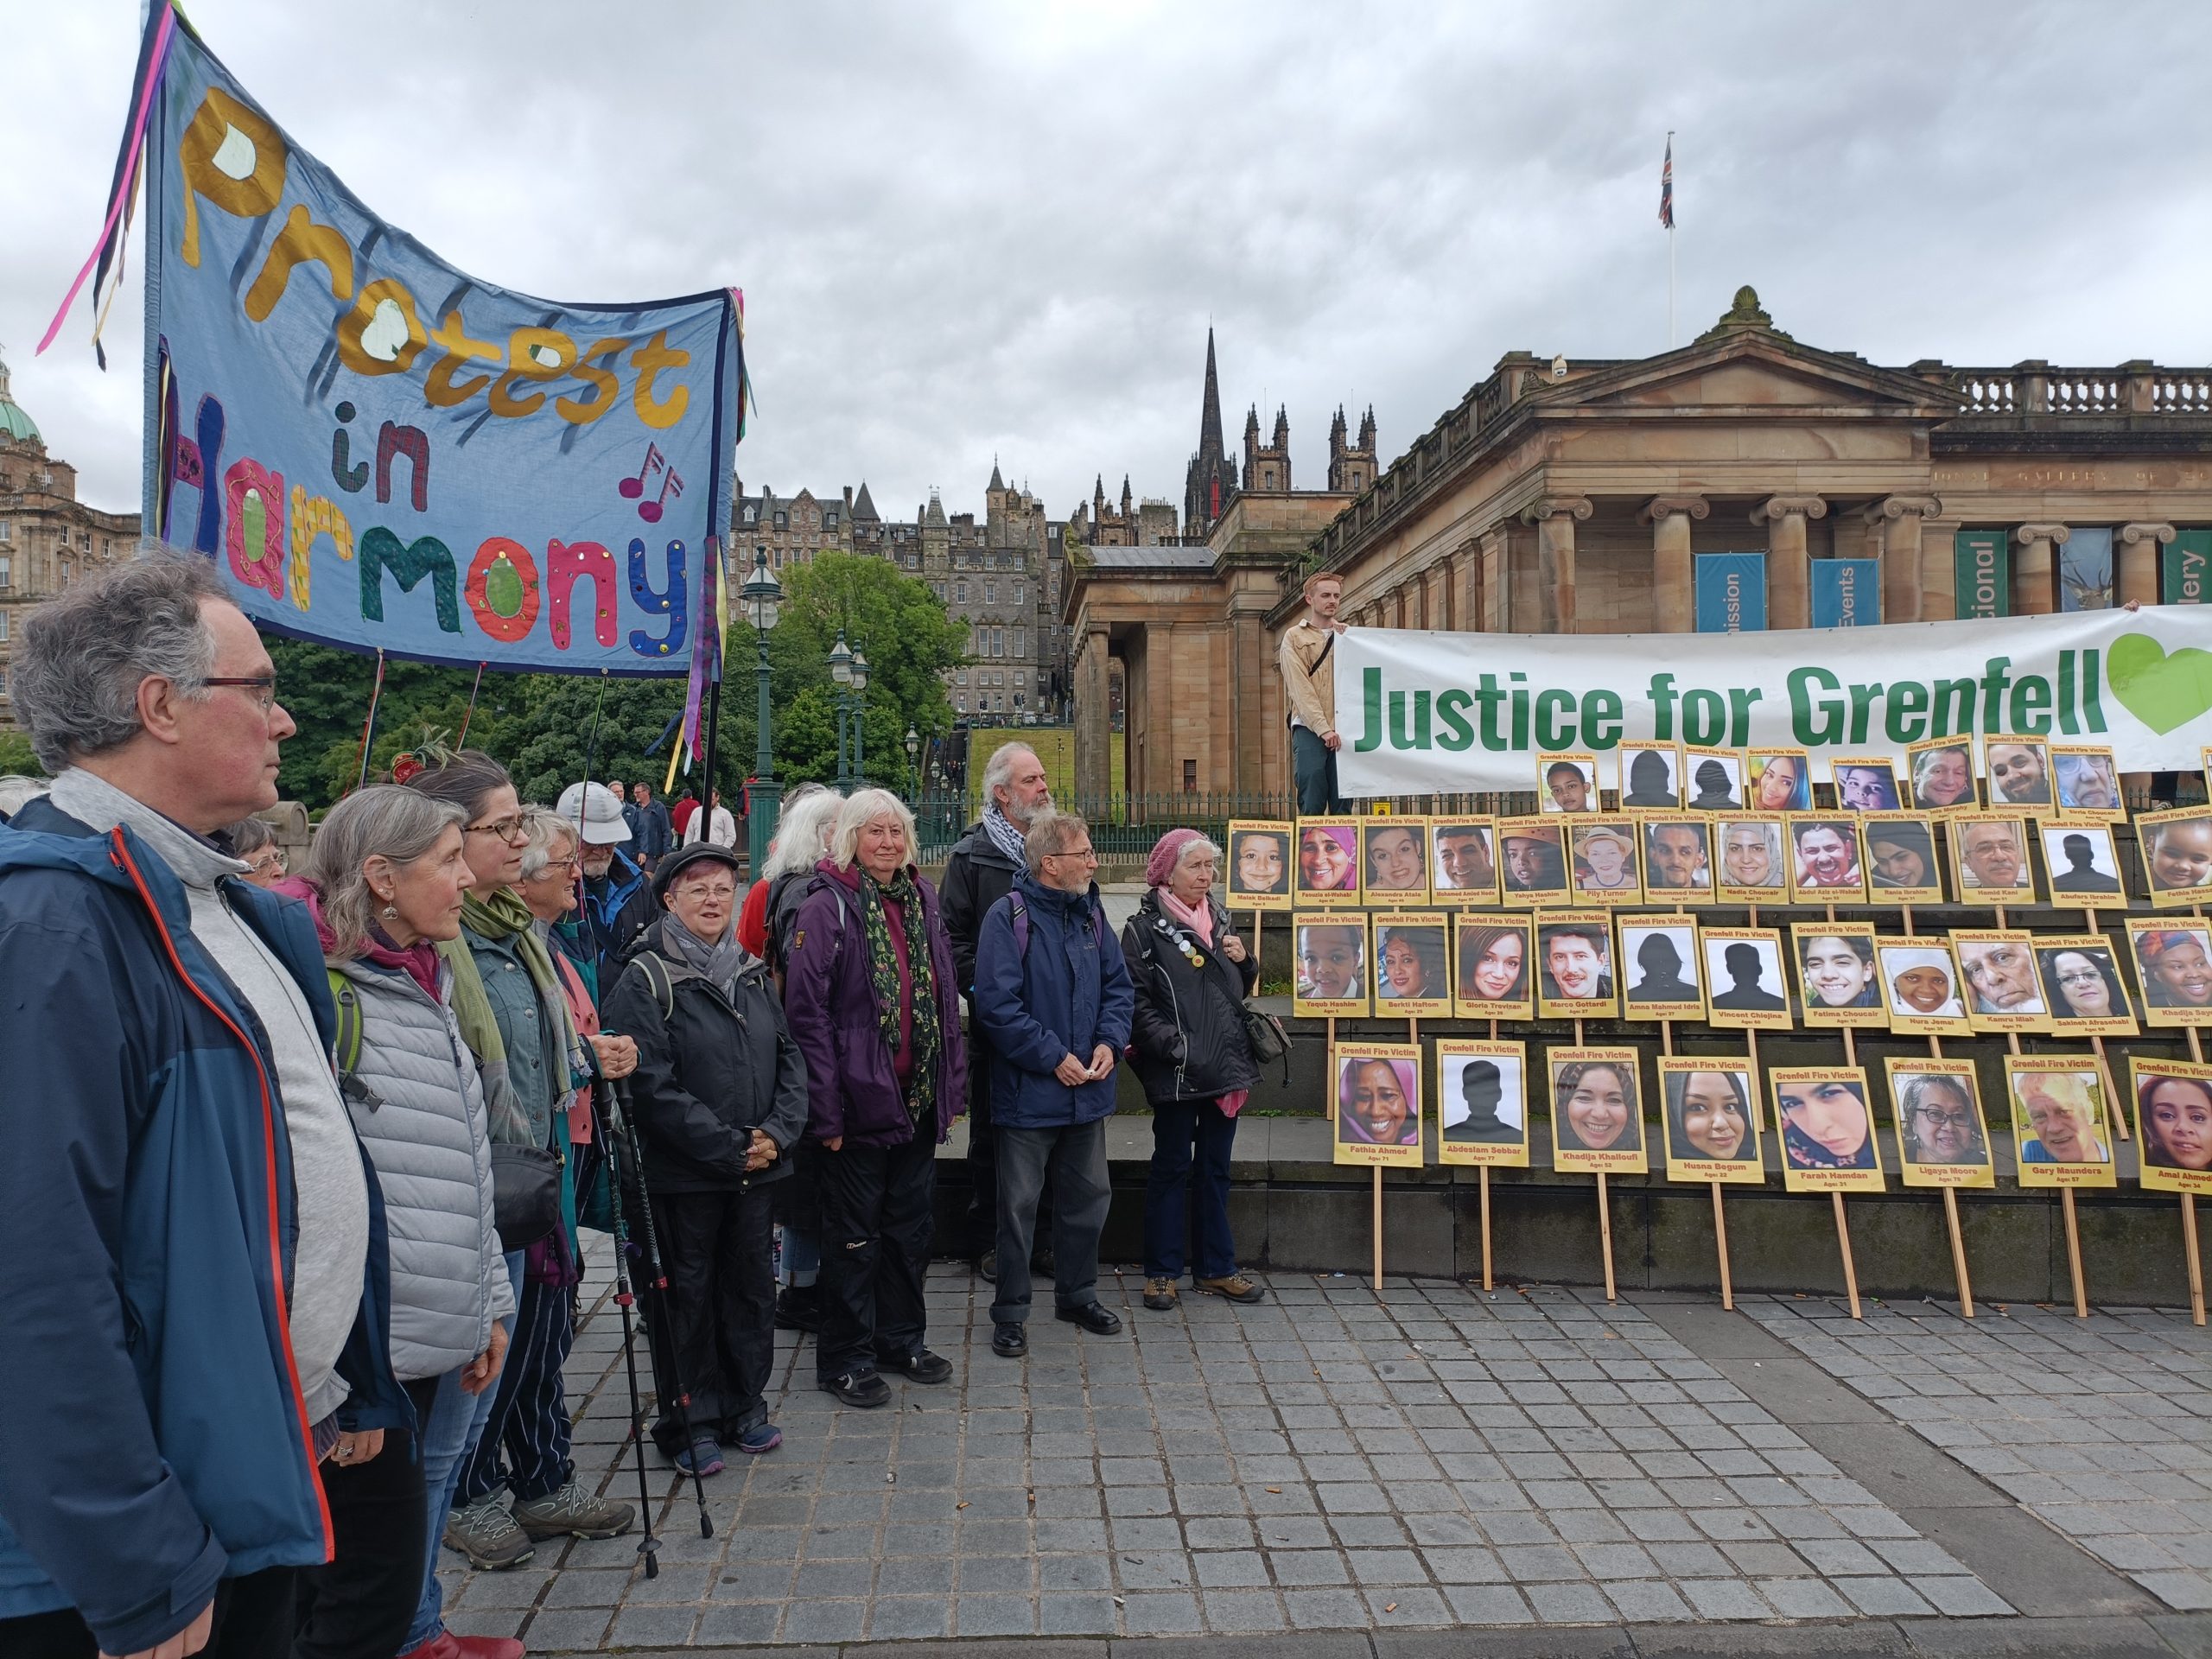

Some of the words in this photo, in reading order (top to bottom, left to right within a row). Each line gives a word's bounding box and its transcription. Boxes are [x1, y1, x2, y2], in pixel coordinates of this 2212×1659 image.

[179, 86, 691, 429] Protest
[332, 400, 430, 513] in
[1838, 567, 1854, 627] Events
[1354, 666, 1624, 753] Justice
[1646, 672, 1763, 748] for
[1786, 649, 2108, 747] Grenfell
[1942, 804, 1967, 813] Murphy
[1537, 913, 1566, 922] Grenfell
[2161, 1008, 2193, 1017] Khadija
[1340, 1046, 1370, 1055] Grenfell
[1372, 1046, 1388, 1056] Fire
[1389, 1047, 1415, 1057] Victim
[1442, 1043, 1473, 1052] Grenfell
[1475, 1044, 1491, 1052] Fire
[1492, 1045, 1519, 1053] Victim
[1552, 1050, 1585, 1058] Grenfell
[1586, 1050, 1603, 1058] Fire
[1604, 1050, 1631, 1058] Victim
[1663, 1060, 1697, 1069] Grenfell
[1699, 1060, 1716, 1069] Fire
[1717, 1060, 1745, 1069] Victim
[1891, 1061, 1923, 1071] Grenfell
[1924, 1062, 1941, 1071] Fire
[1942, 1063, 1968, 1072] Victim
[2011, 1059, 2045, 1068] Grenfell
[2047, 1059, 2064, 1068] Fire
[2065, 1059, 2094, 1068] Victim
[2135, 1062, 2170, 1073] Grenfell
[2171, 1065, 2188, 1075] Fire
[1775, 1071, 1809, 1079] Grenfell
[1811, 1071, 1828, 1079] Fire
[1829, 1071, 1859, 1079] Victim
[1349, 1145, 1376, 1154] Fathia
[1377, 1146, 1407, 1155] Ahmed
[1446, 1144, 1488, 1154] Abdeslam
[1490, 1146, 1521, 1154] Sebbar
[1562, 1152, 1596, 1160] Khadija
[1682, 1161, 1712, 1170] Husna
[1713, 1162, 1746, 1172] Begum
[1918, 1166, 1948, 1176] Ligaya
[1948, 1166, 1977, 1175] Moore
[2031, 1166, 2054, 1175] Gary
[2056, 1166, 2101, 1175] Maunders
[1828, 1171, 1867, 1179] Hamdan
[2157, 1169, 2180, 1179] Amal
[2181, 1172, 2212, 1182] Ahmed
